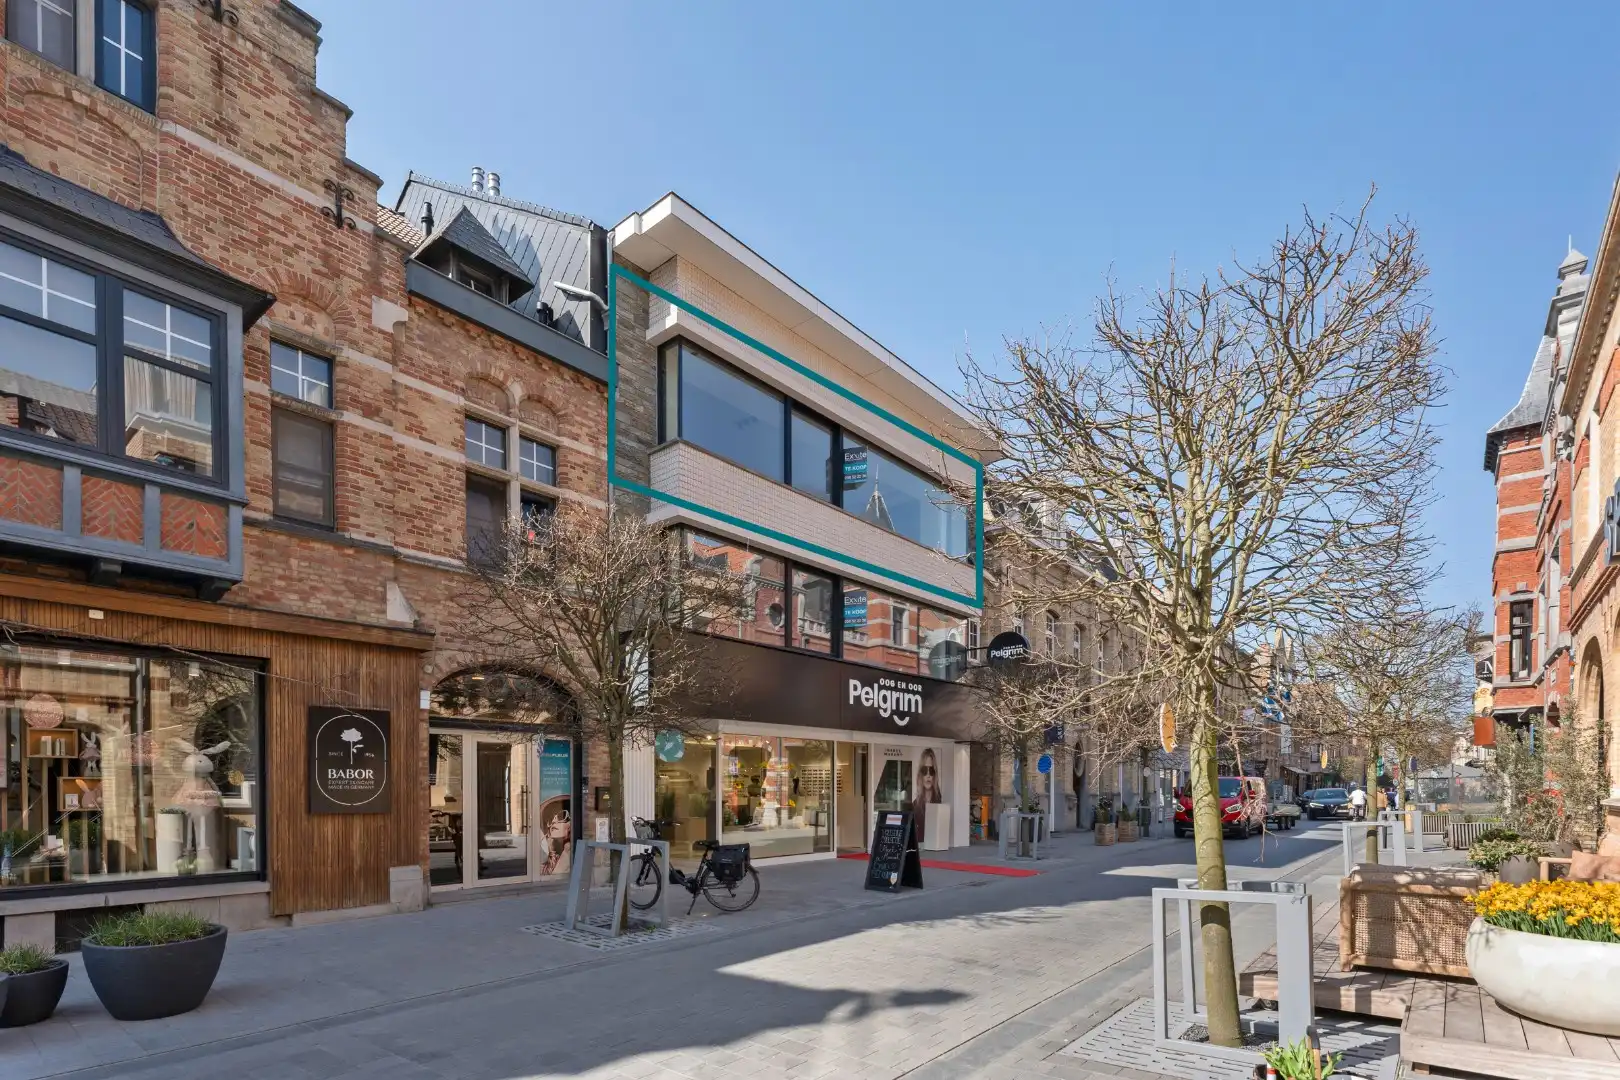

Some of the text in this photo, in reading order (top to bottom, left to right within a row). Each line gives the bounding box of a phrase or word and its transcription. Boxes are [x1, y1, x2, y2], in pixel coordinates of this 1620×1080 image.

[990, 648, 1024, 659] Pelgrim
[880, 678, 896, 688] OOG
[908, 684, 922, 692] OOR
[849, 679, 922, 718] Pelgrim
[328, 768, 374, 779] BABOR
